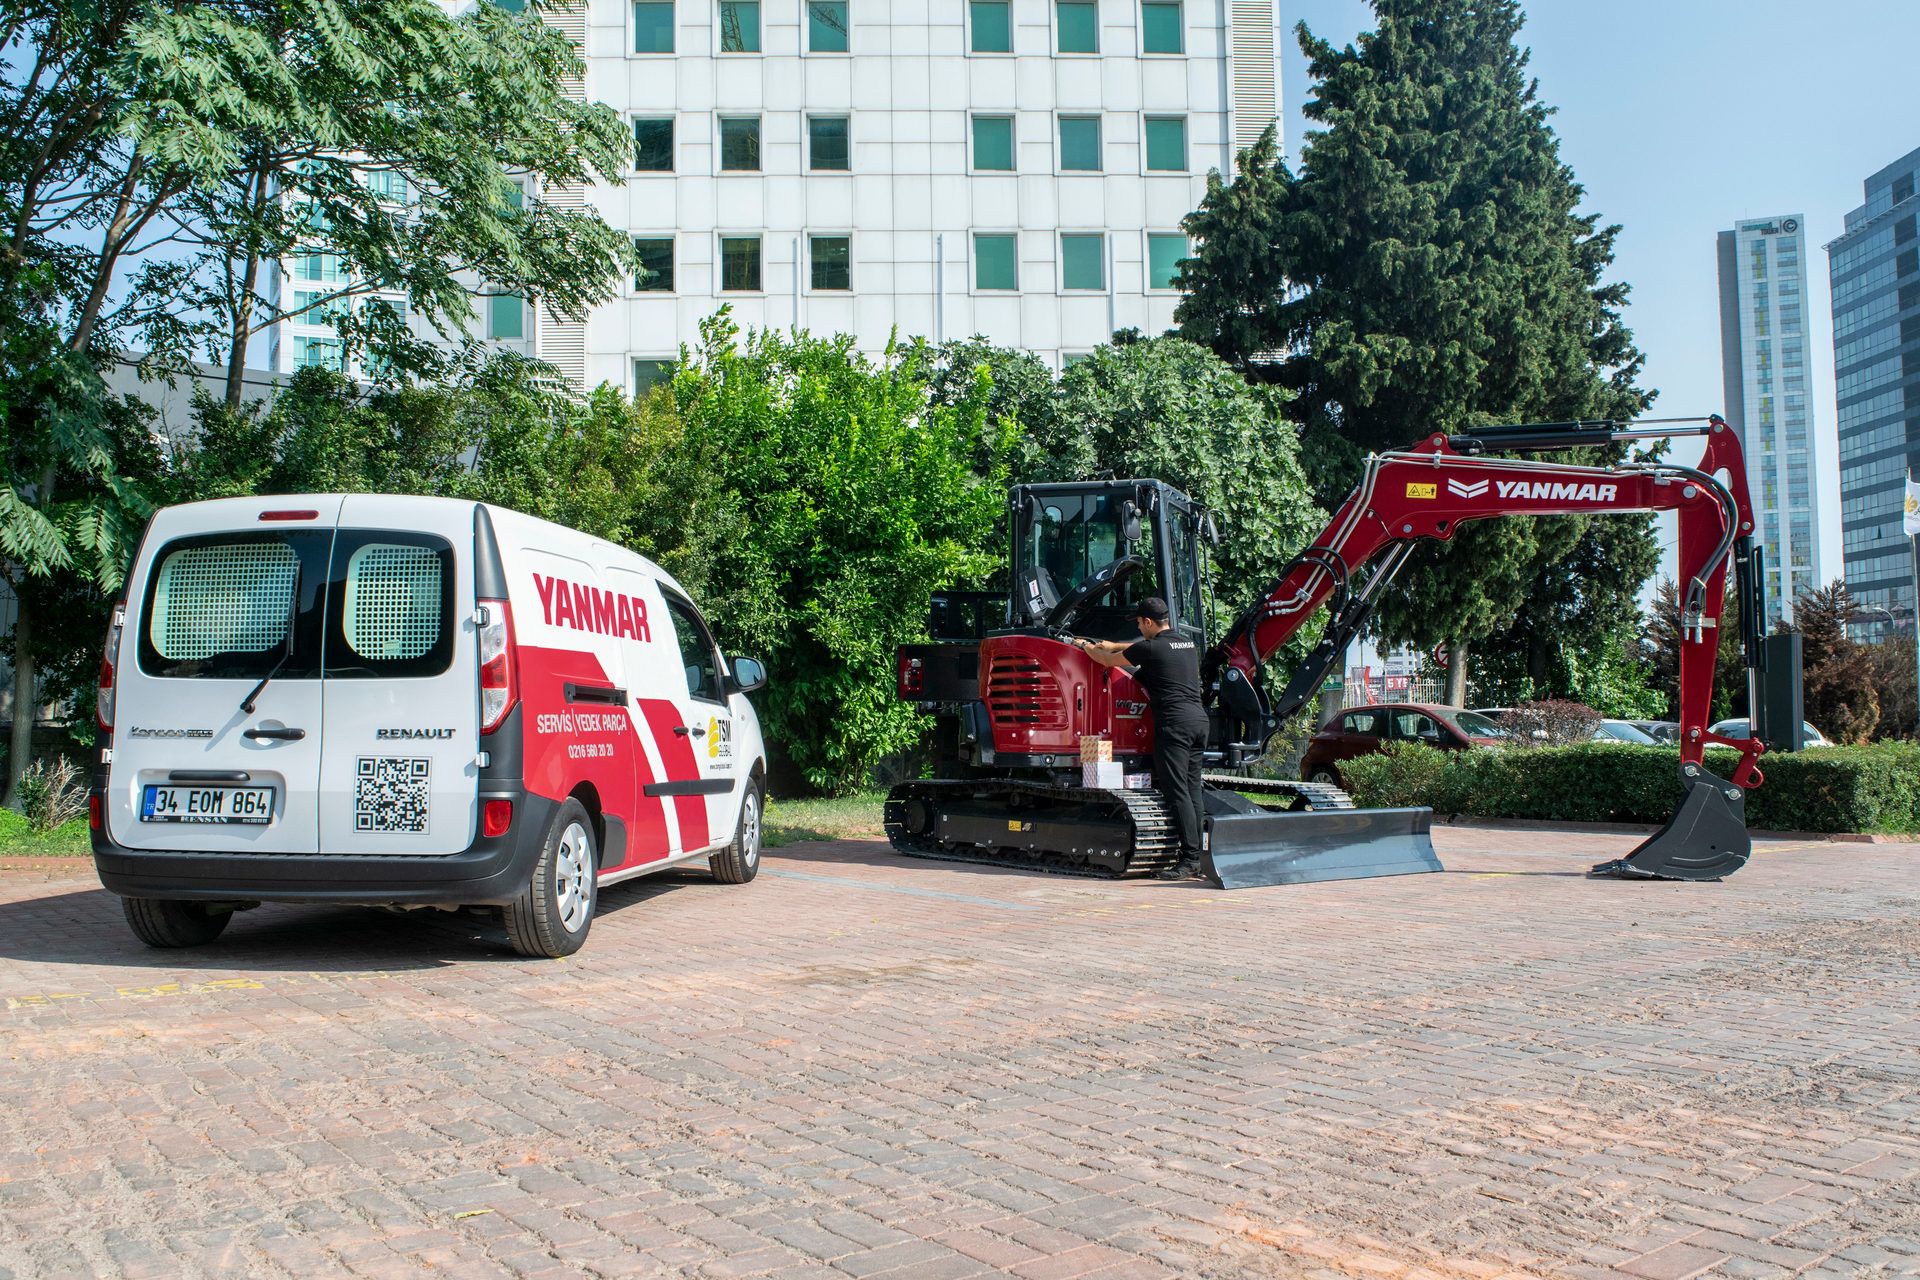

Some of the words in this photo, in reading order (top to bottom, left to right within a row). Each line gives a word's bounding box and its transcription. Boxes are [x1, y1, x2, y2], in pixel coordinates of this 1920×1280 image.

[1496, 481, 1617, 501] YANMAR
[533, 573, 651, 643] YANMAR
[1130, 703, 1147, 714] 57
[537, 709, 573, 734] SERVİS
[575, 714, 602, 732] YEDEK
[602, 714, 627, 735] PARÇA
[717, 719, 731, 742] TSM
[377, 728, 456, 740] RENAULT
[568, 744, 586, 759] 0216
[598, 743, 606, 756] 20
[606, 743, 614, 756] 20
[147, 802, 155, 810] TR
[156, 790, 178, 812] 34
[188, 790, 224, 813] EOM
[232, 791, 267, 814] 864
[180, 815, 228, 823] RENSAN
